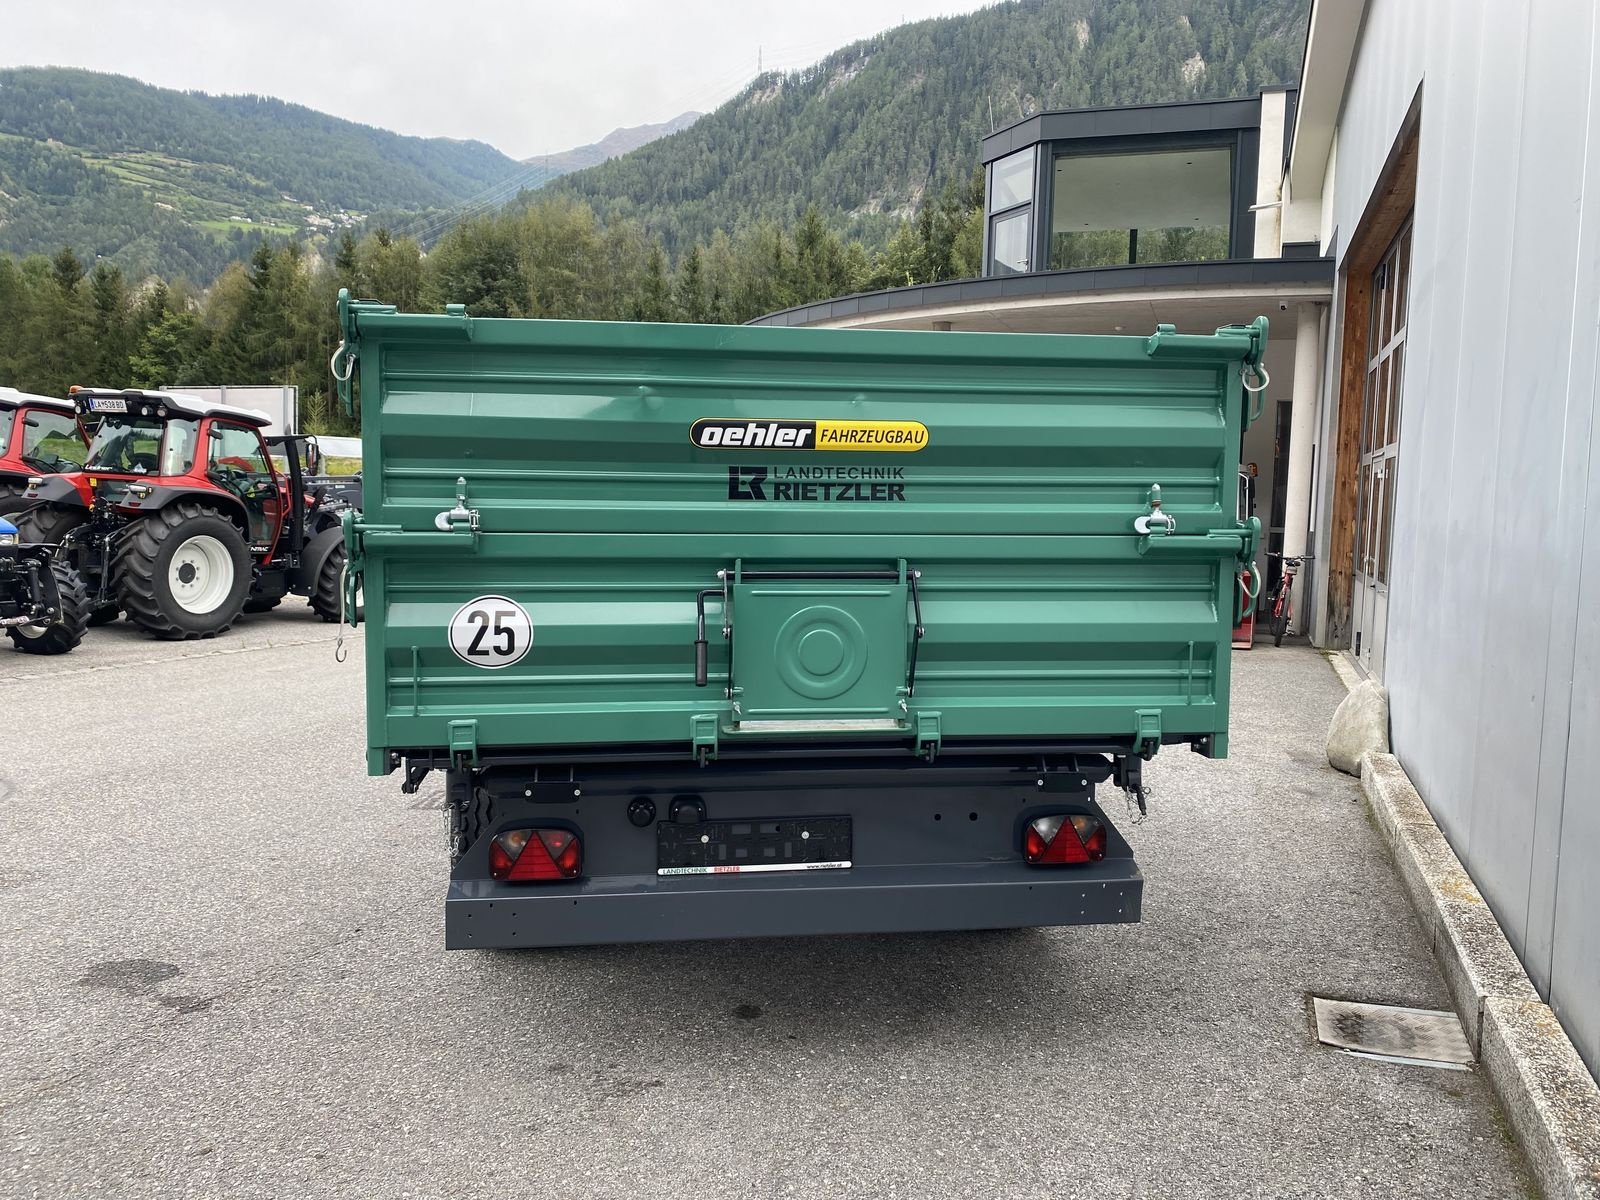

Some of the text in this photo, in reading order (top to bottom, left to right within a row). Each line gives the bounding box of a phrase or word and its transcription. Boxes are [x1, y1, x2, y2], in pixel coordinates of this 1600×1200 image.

[700, 423, 925, 447] oehler FAHRZEUGBAU
[773, 466, 905, 479] LANDTECHNIK
[773, 483, 906, 501] RIETZLER
[467, 610, 516, 656] 25
[662, 867, 707, 875] LANDTECHNIK
